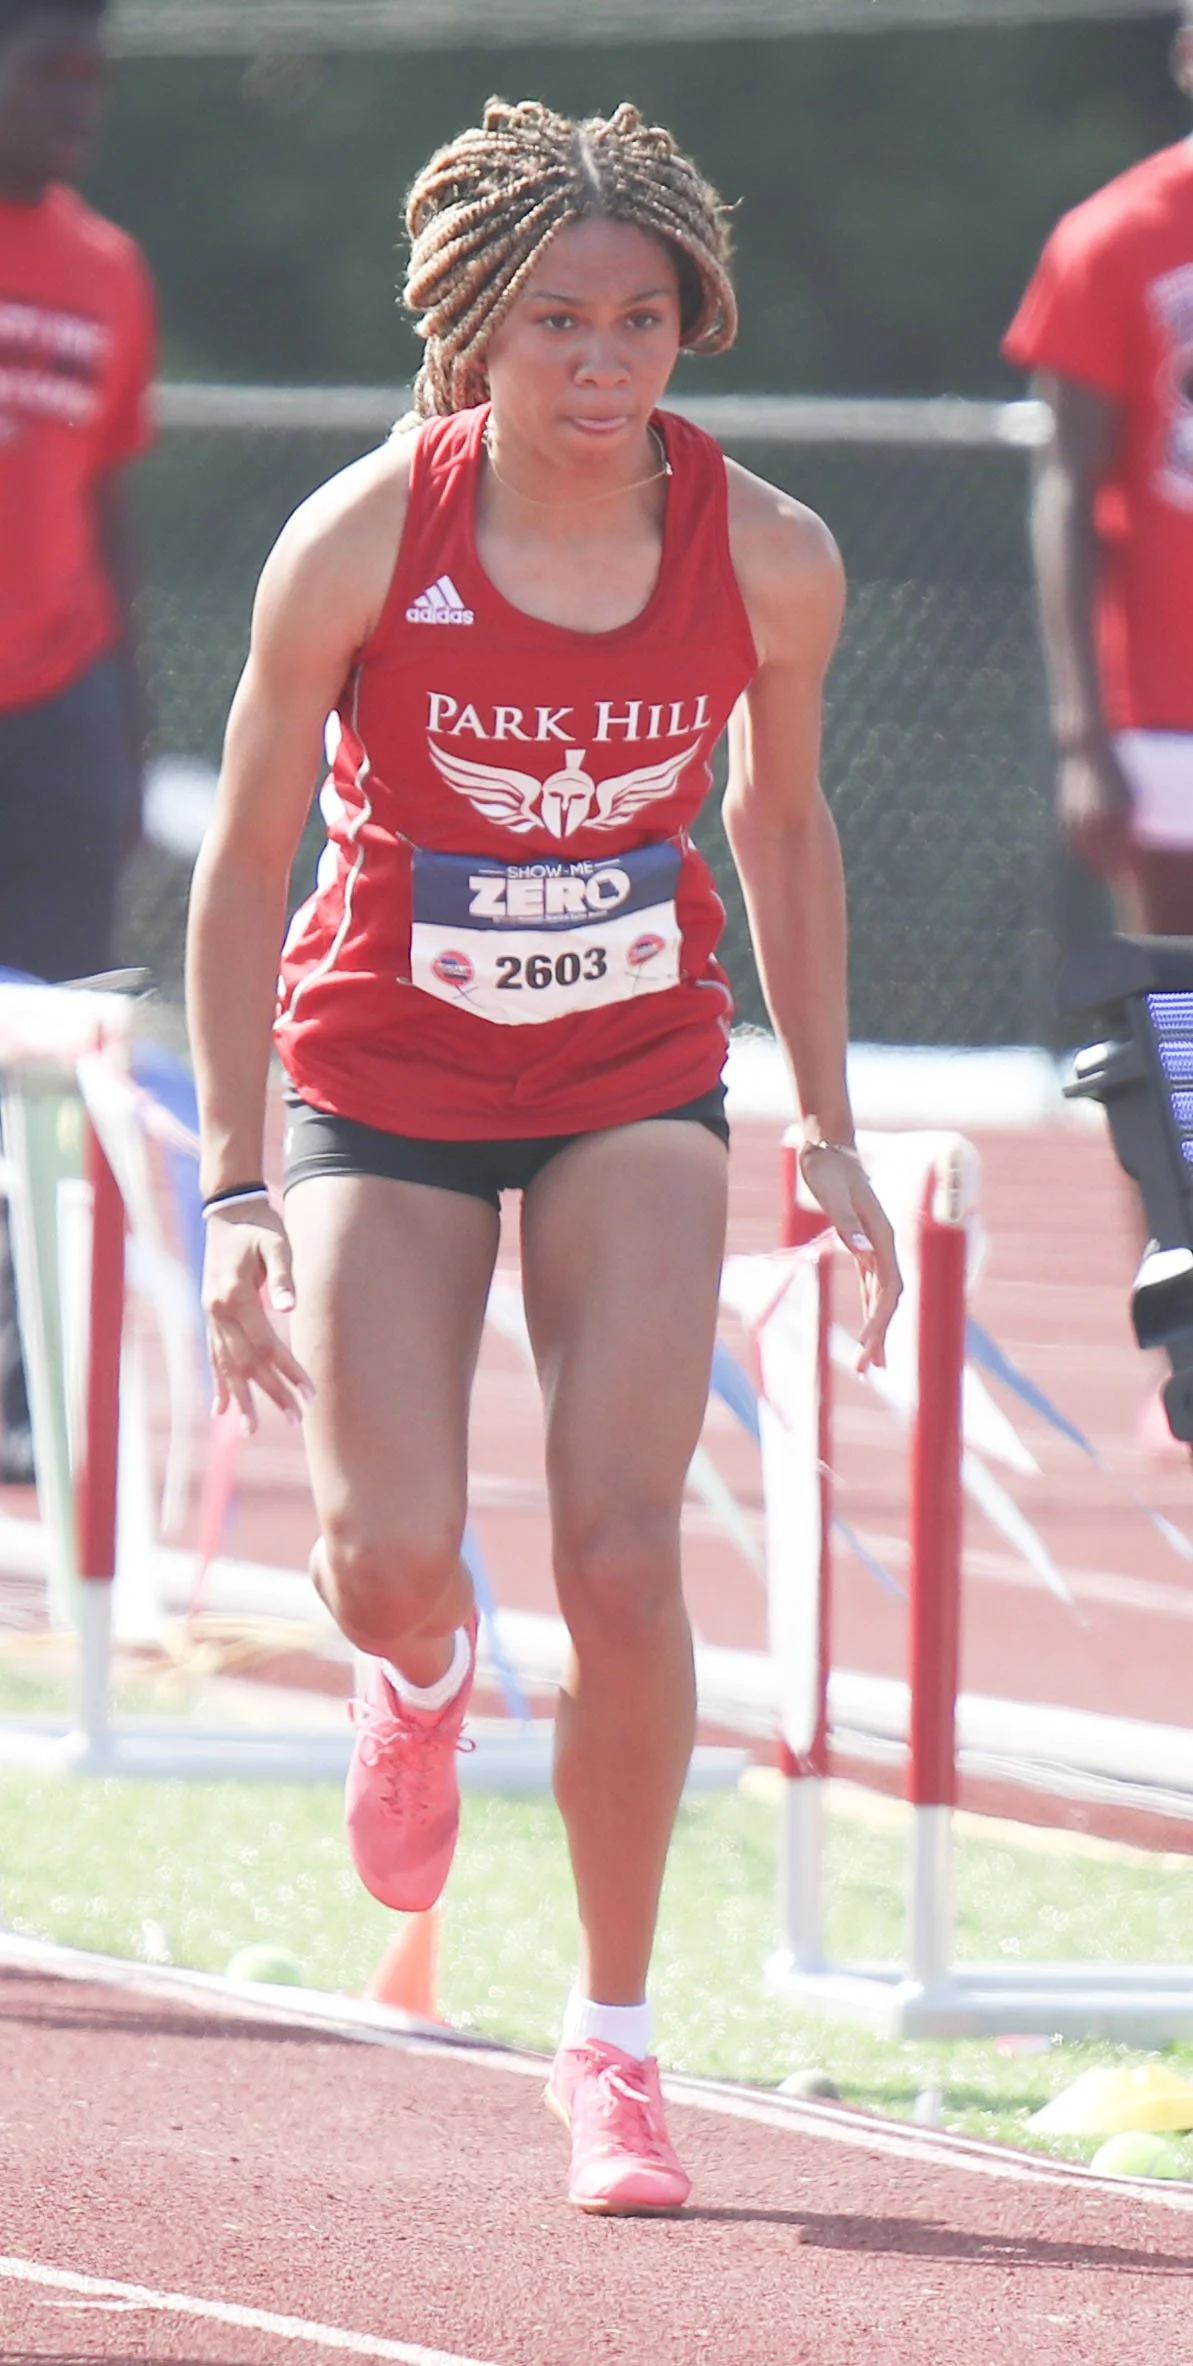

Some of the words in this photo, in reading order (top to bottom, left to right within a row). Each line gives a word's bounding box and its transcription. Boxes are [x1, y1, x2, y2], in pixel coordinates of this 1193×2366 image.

[405, 607, 475, 626] adidas
[425, 690, 576, 742] PARK
[592, 695, 711, 742] HILL
[506, 861, 594, 879] SHOW-ME
[468, 868, 631, 918] ZERO
[495, 947, 608, 990] 2603
